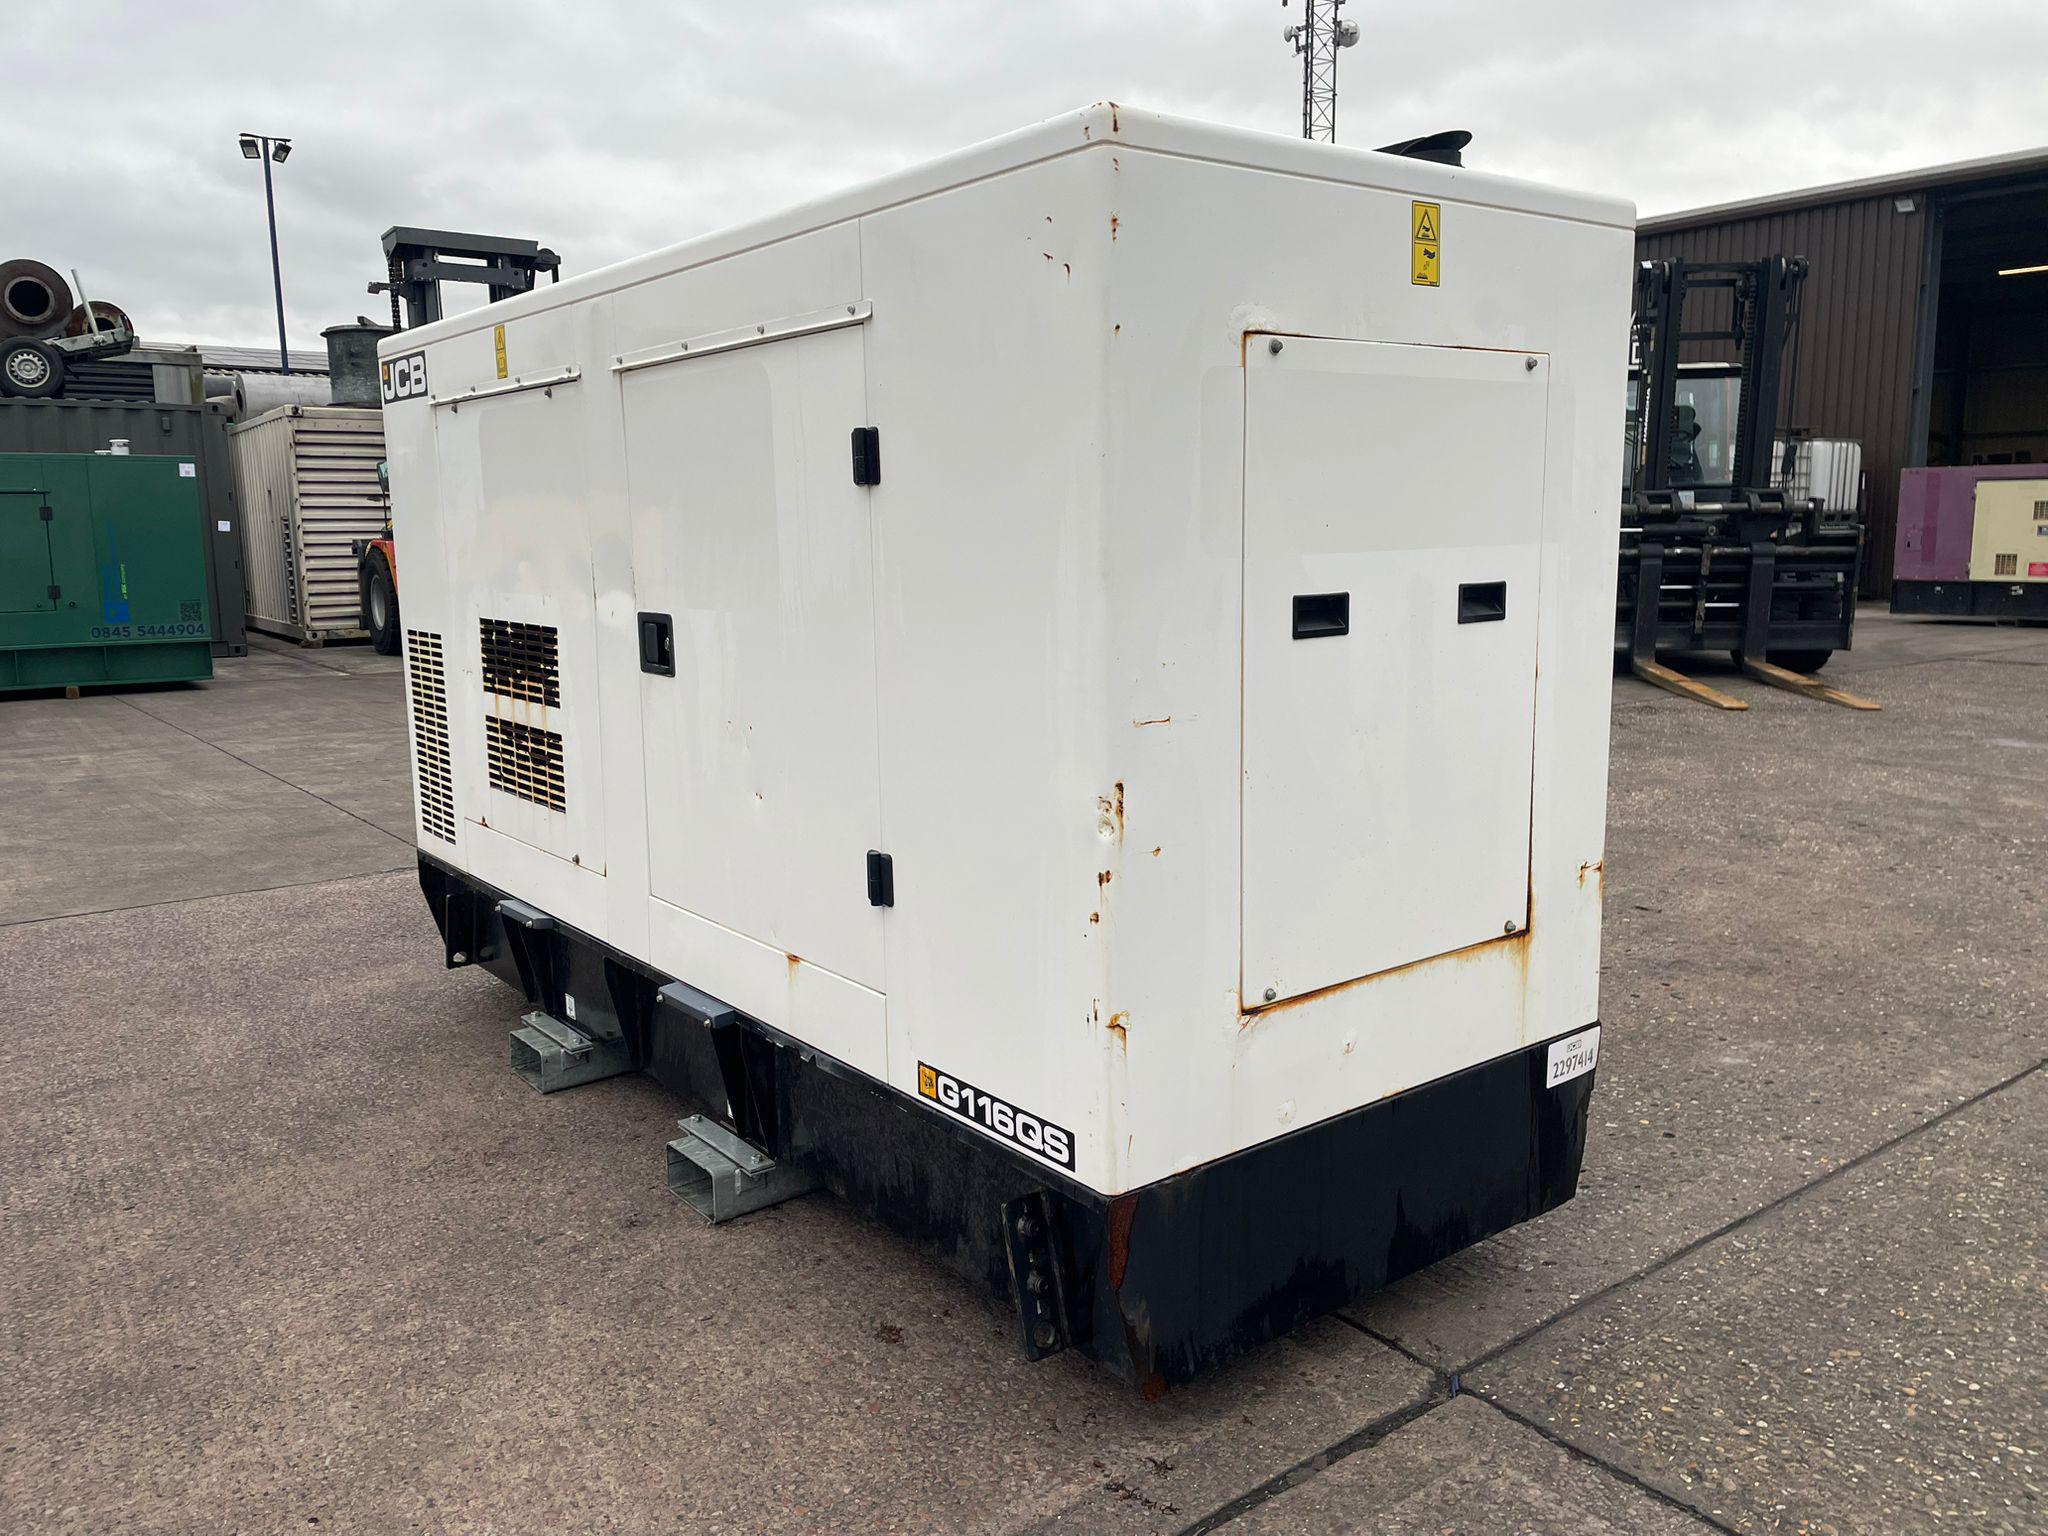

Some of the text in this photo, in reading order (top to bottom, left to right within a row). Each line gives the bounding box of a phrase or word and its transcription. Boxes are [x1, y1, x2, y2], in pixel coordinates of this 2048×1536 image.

[383, 355, 426, 400] JCB
[91, 624, 205, 638] 0845 5444904
[1553, 1048, 1594, 1079] 2297414
[938, 1075, 1070, 1164] G116QS
